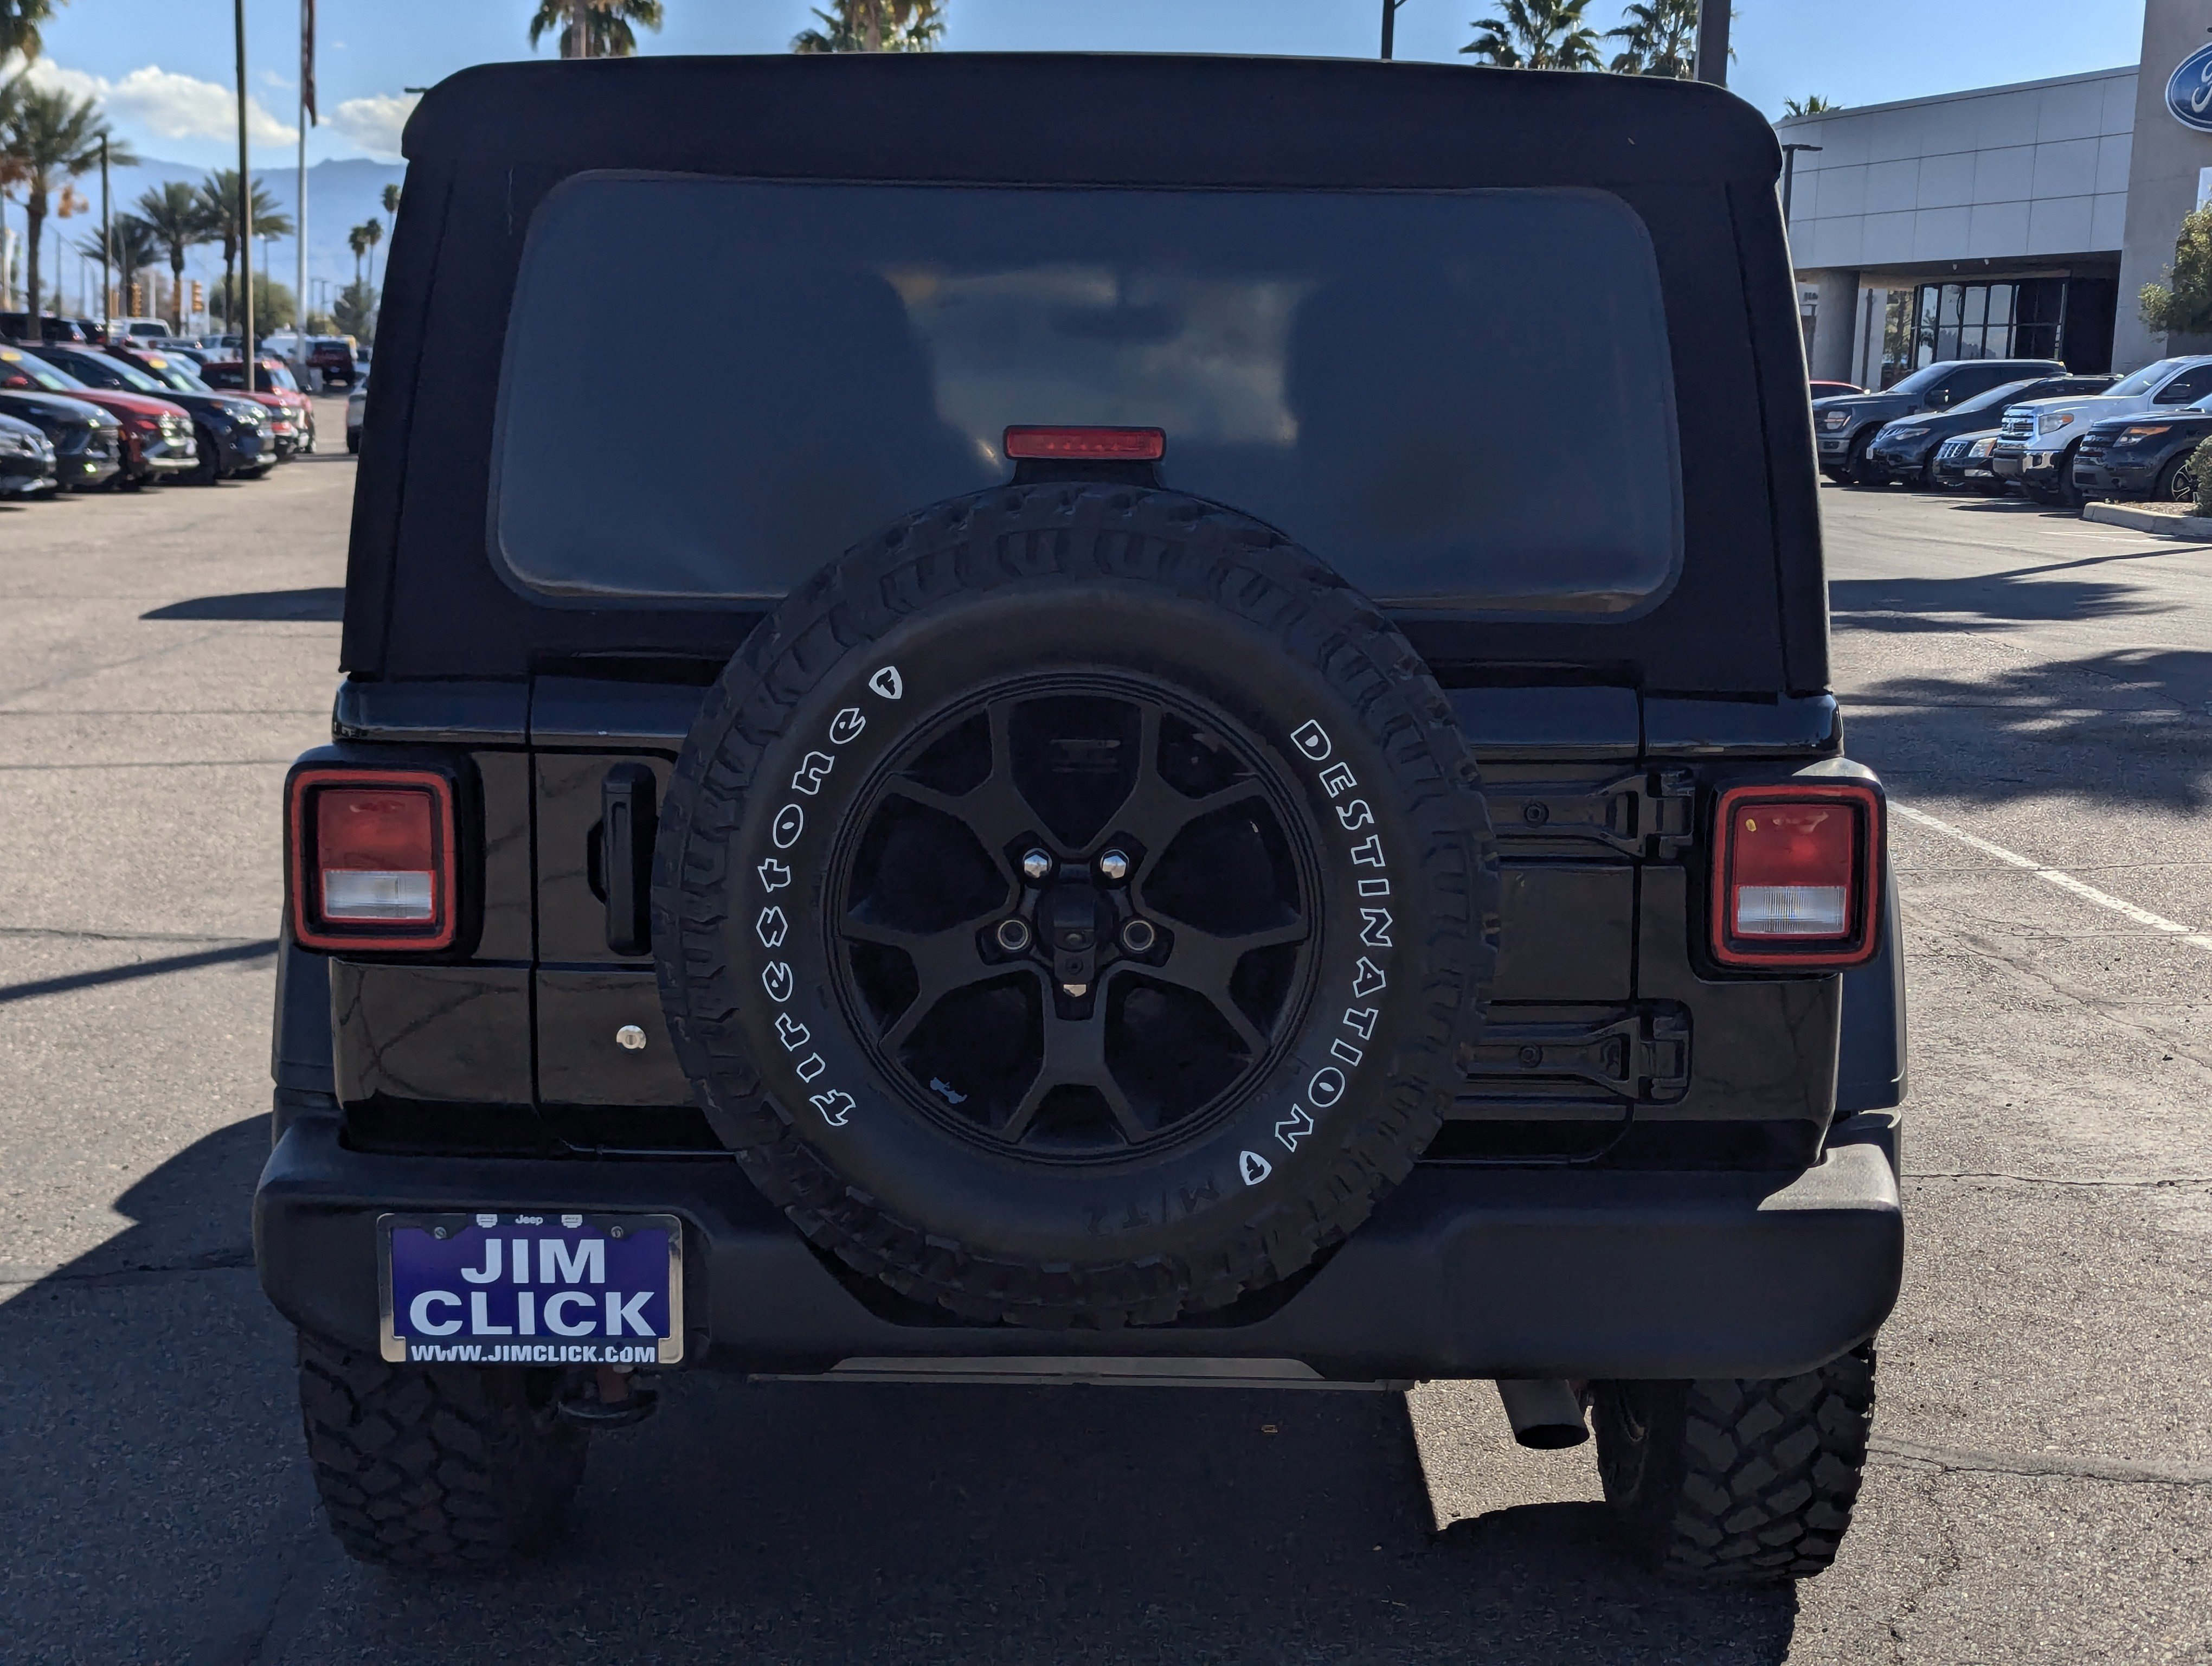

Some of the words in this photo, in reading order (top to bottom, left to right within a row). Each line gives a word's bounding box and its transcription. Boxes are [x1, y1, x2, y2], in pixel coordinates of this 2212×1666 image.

[756, 707, 866, 1127] Firestone
[1274, 719, 1393, 1153] DESTINATION
[515, 1214, 543, 1226] Jeep
[461, 1239, 605, 1284] JIM
[409, 1290, 657, 1336] CLICK
[411, 1344, 655, 1363] WWW.JIMCLICK.COM
